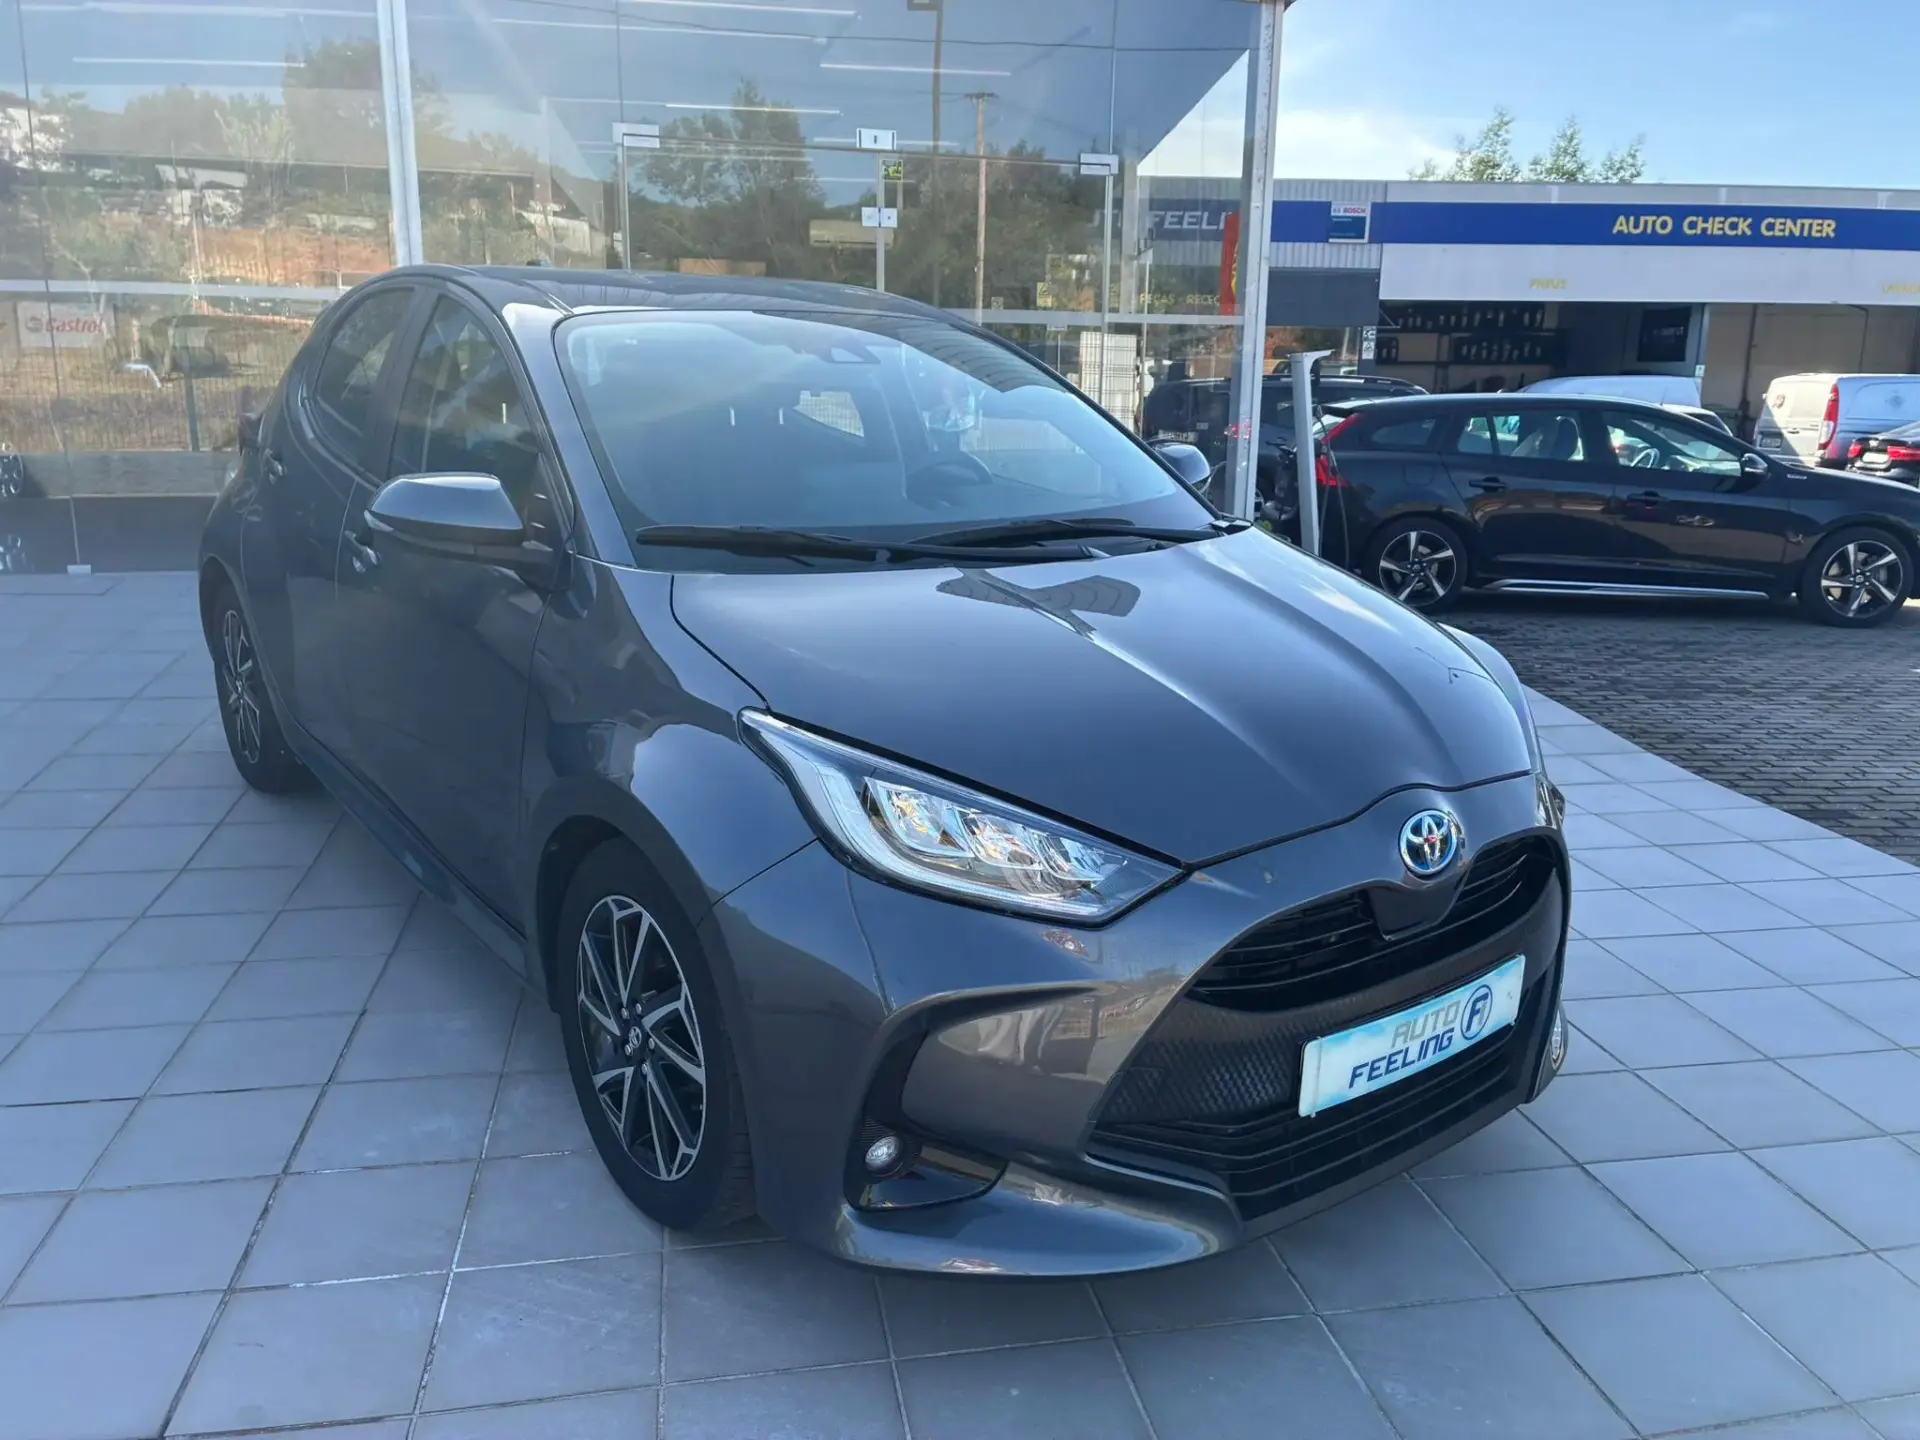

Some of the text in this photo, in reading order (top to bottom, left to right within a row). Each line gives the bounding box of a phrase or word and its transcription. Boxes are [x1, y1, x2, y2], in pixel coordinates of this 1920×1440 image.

[1147, 210, 1232, 230] FEELI
[1612, 215, 1837, 238] AUTO CHECK CENTER
[1391, 1000, 1461, 1049] AUTO
[1349, 1027, 1455, 1089] FEELING
